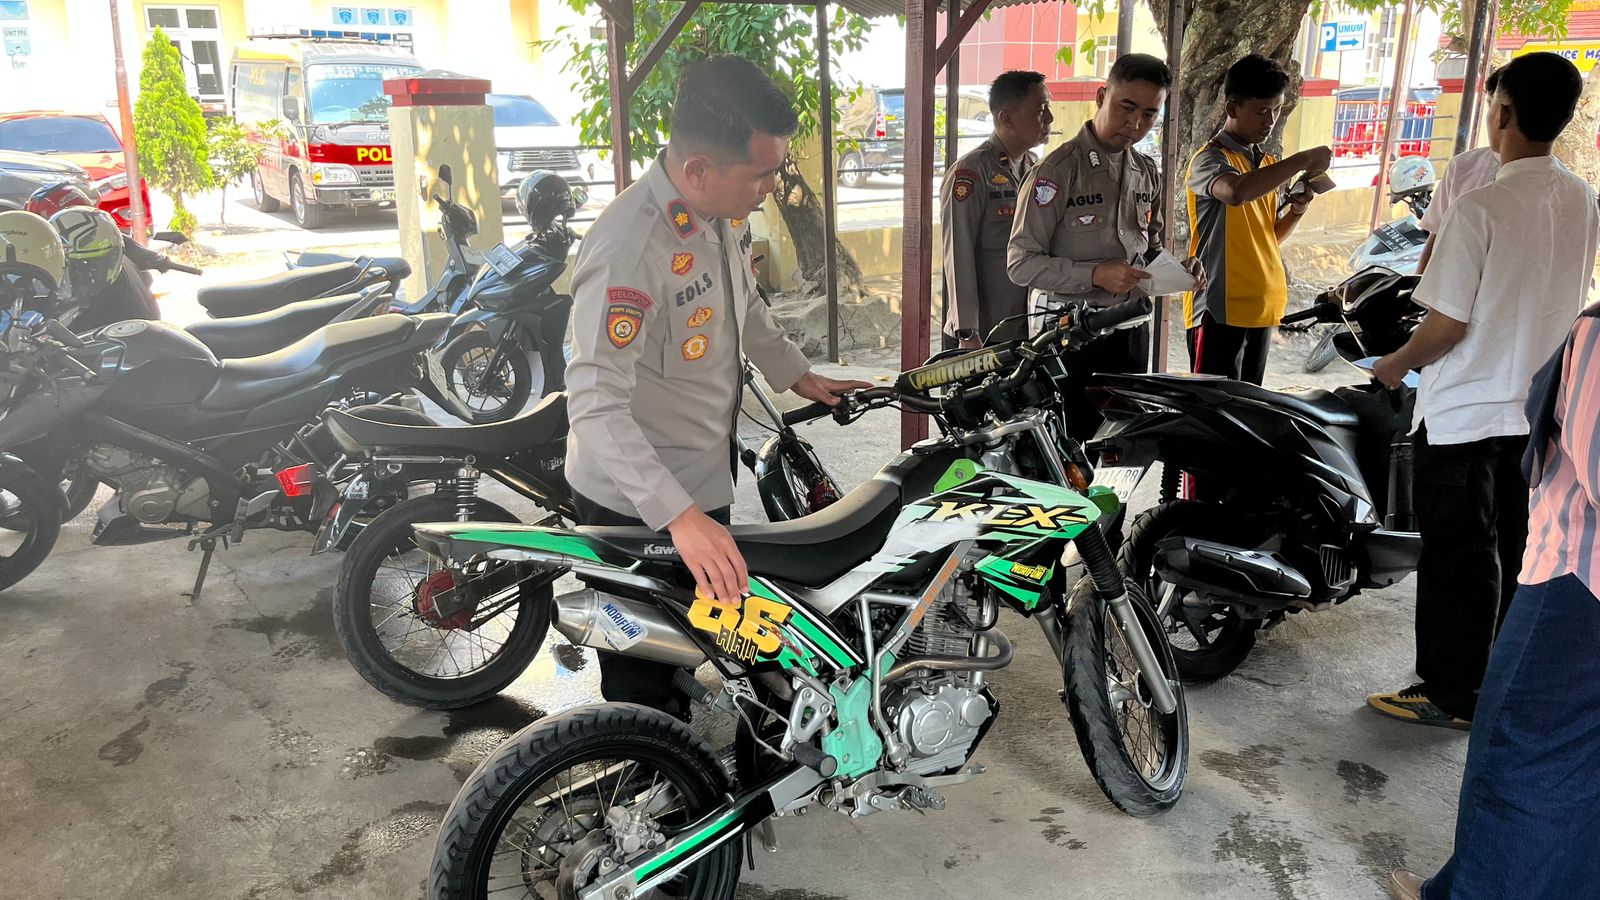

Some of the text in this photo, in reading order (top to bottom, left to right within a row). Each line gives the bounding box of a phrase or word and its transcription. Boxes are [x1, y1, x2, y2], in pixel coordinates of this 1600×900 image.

[1320, 24, 1363, 49] P UMUM
[1066, 192, 1104, 209] AGUS
[674, 272, 713, 308] EDI.S
[915, 353, 995, 389] PROTAPER
[602, 602, 639, 640] NORIFUMI
